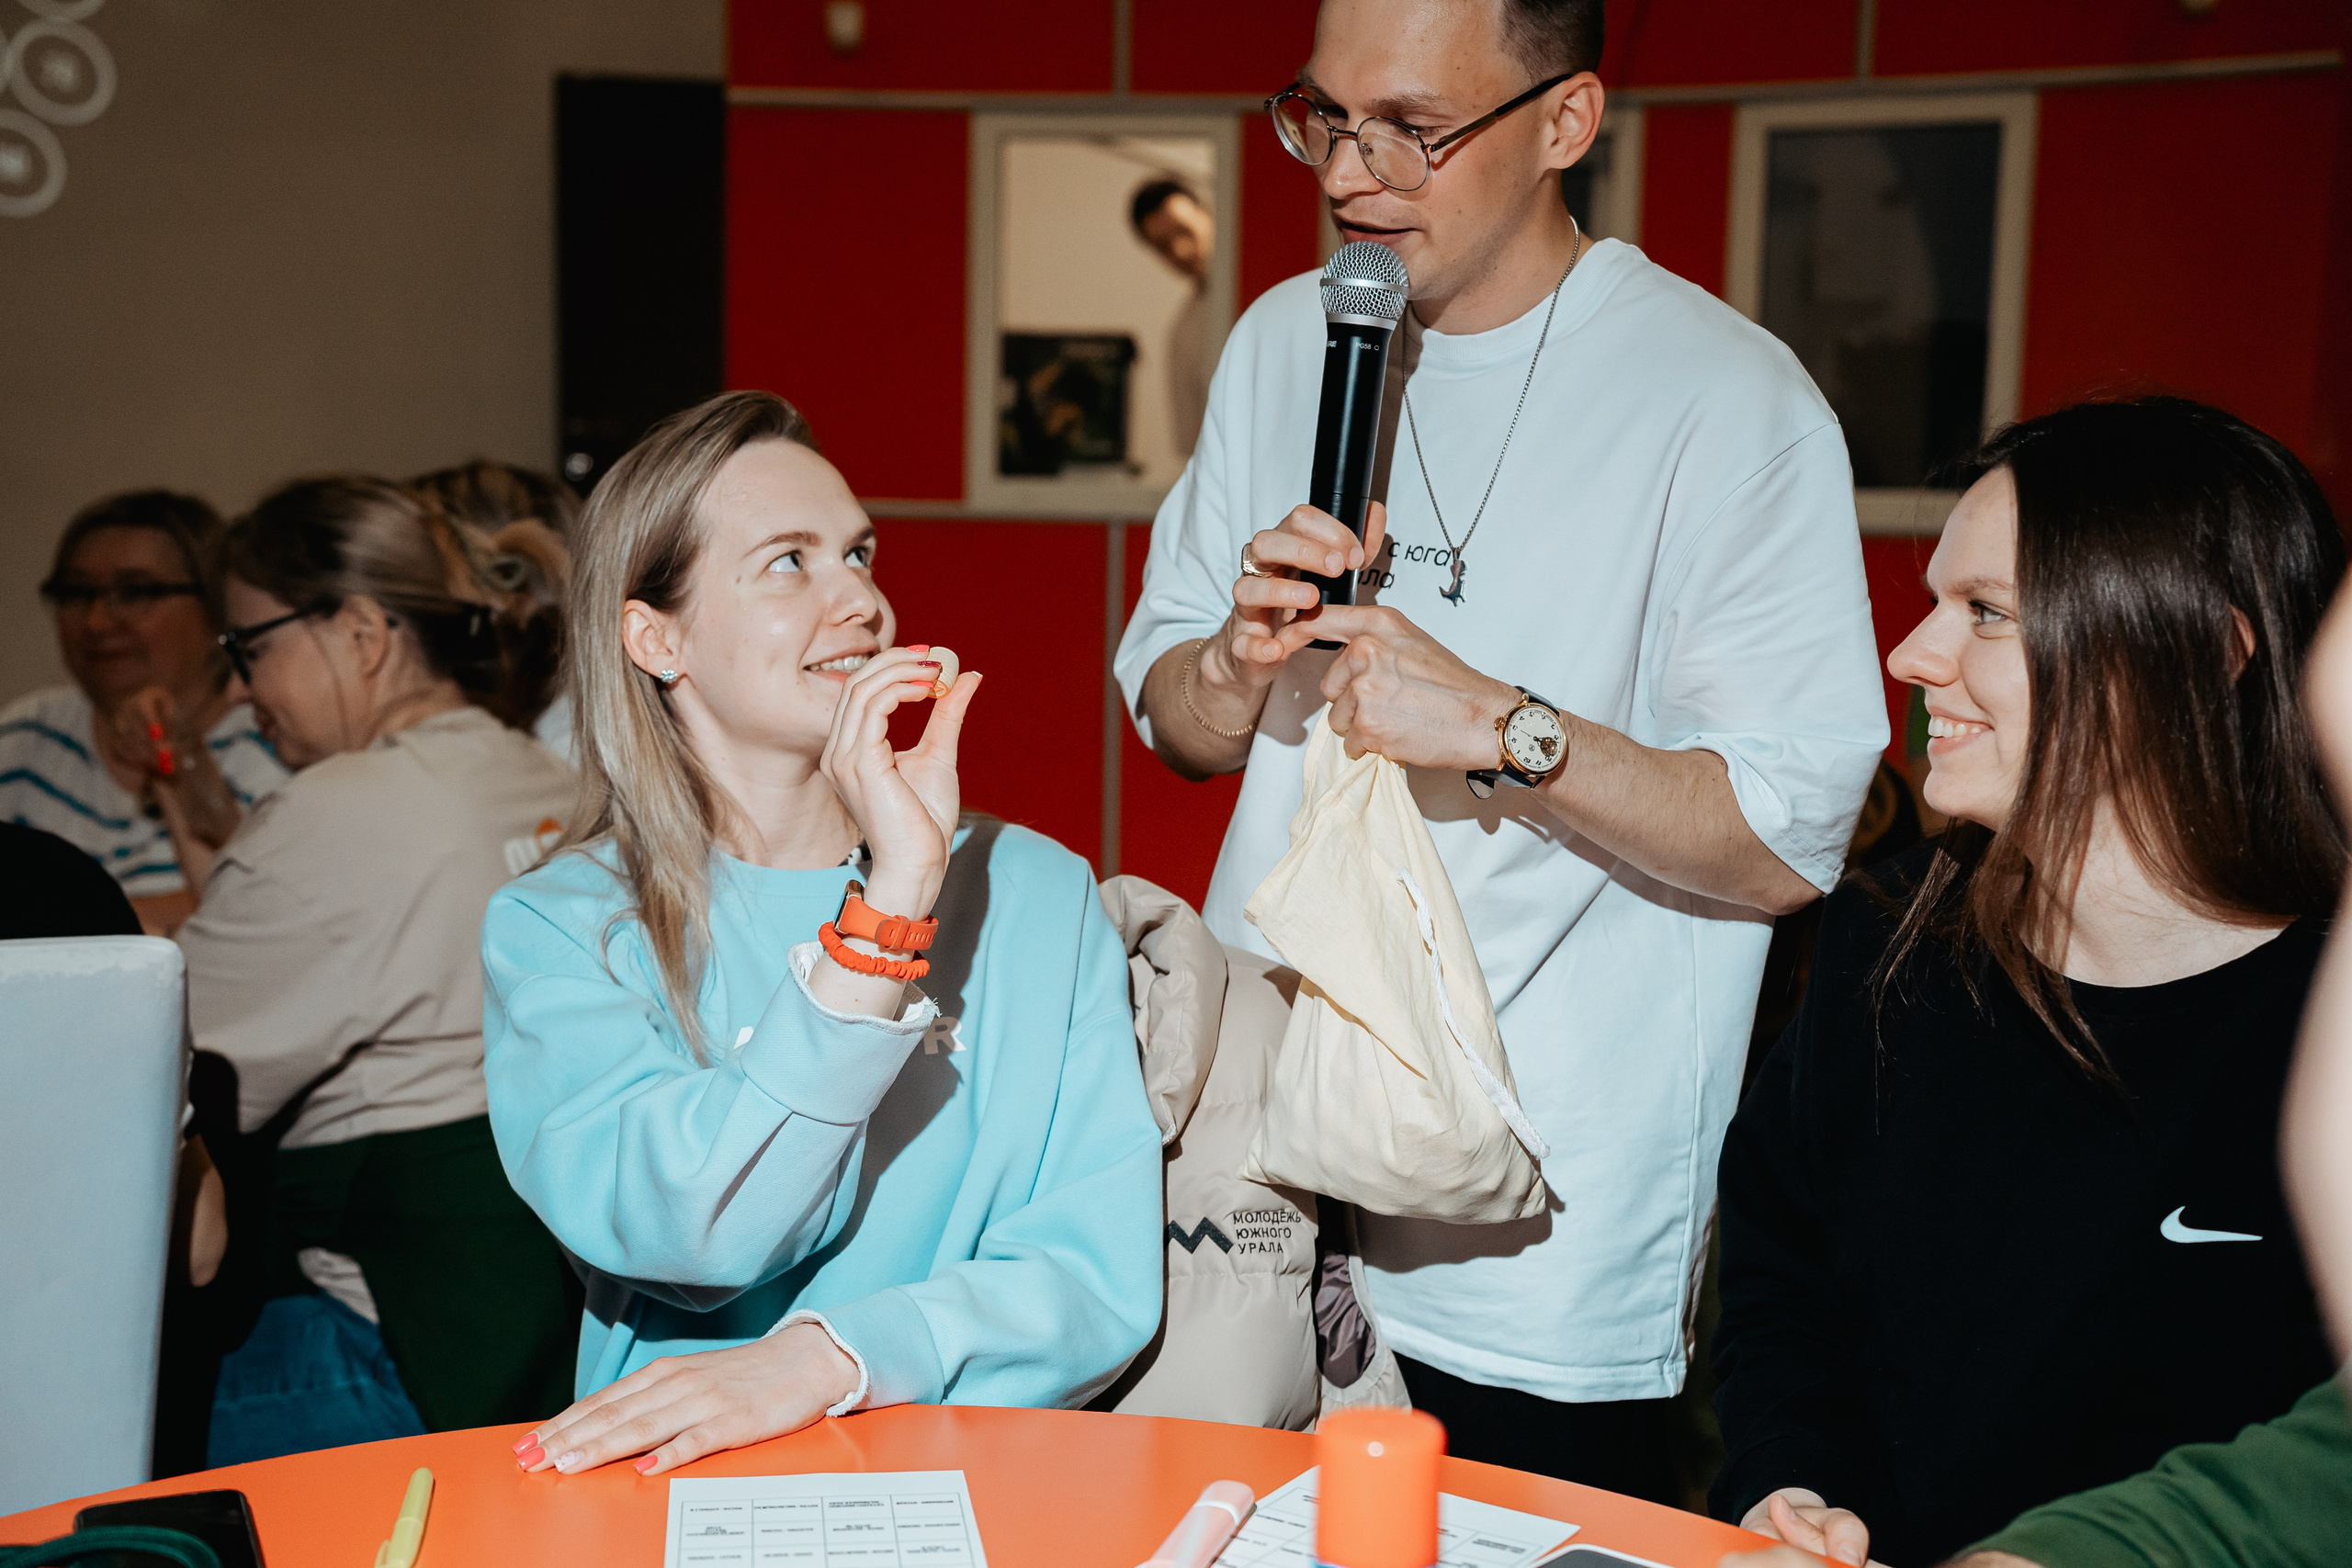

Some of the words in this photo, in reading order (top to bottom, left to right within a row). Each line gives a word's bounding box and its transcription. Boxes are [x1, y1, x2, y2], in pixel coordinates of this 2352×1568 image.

[1355, 342, 1372, 350] PG58
[1405, 545, 1451, 567] юга
[1358, 569, 1396, 589] ла
[1233, 1208, 1301, 1224] МОЛОДЁЖЬ
[1237, 1228, 1291, 1239] ЮЖНОГО
[1238, 1242, 1283, 1254] УРАЛА
